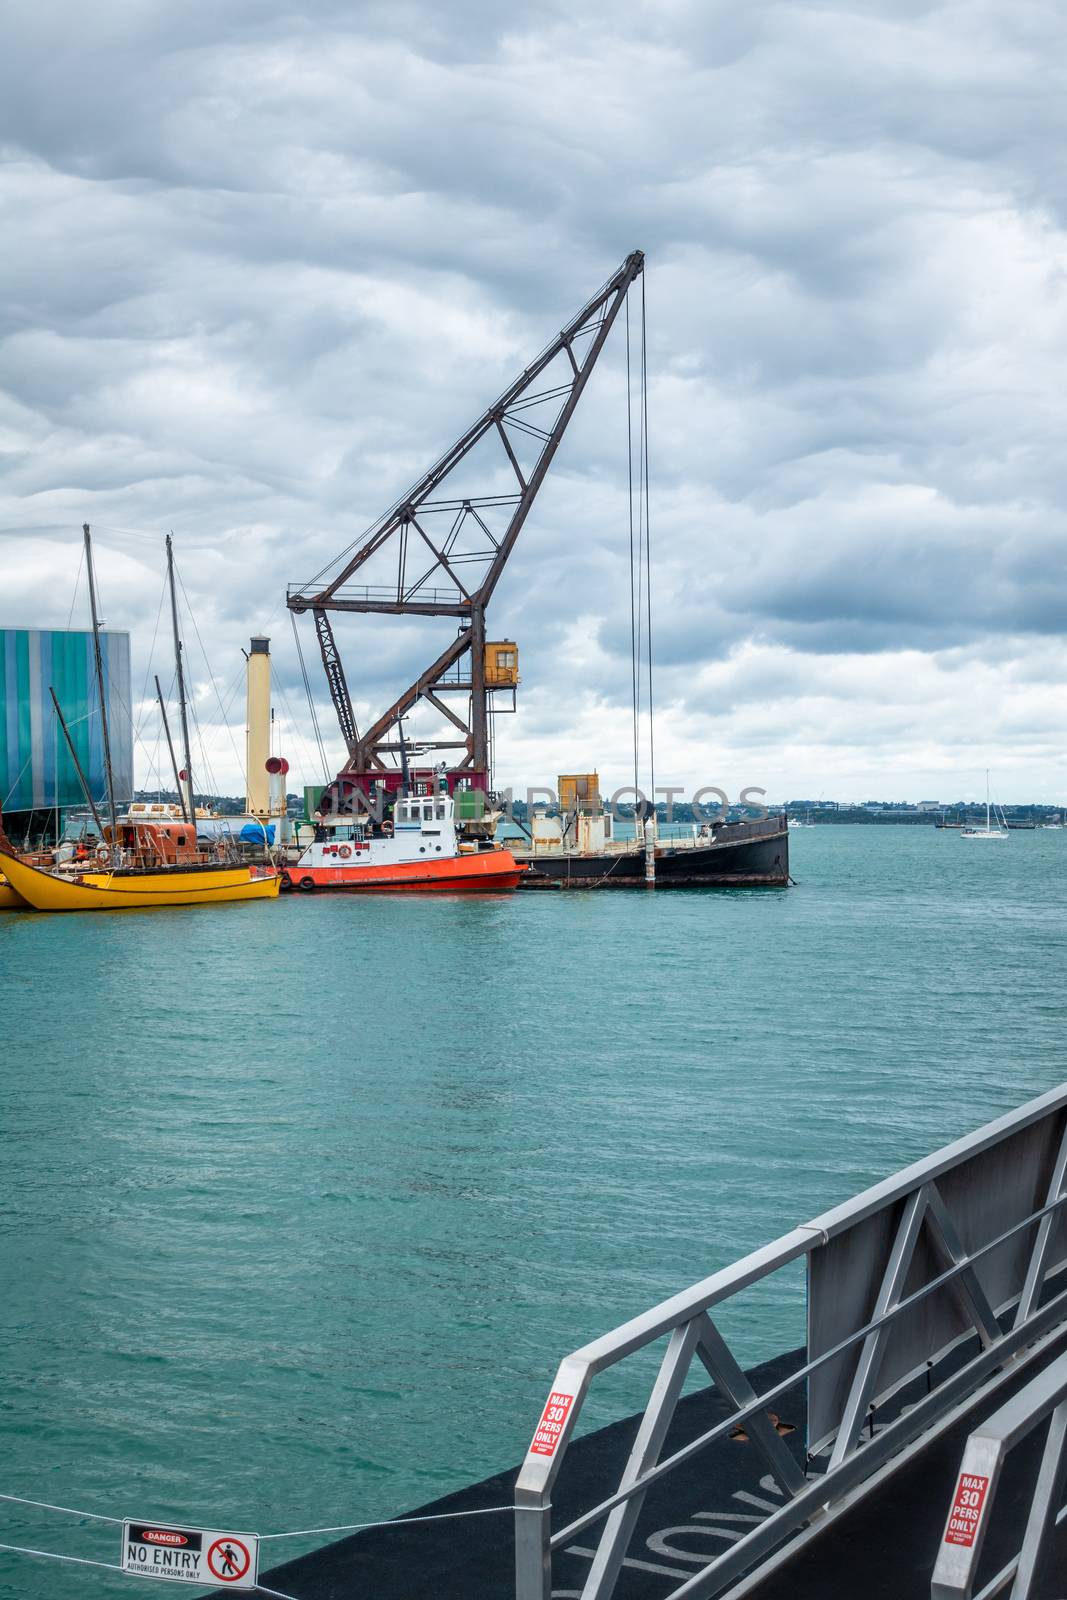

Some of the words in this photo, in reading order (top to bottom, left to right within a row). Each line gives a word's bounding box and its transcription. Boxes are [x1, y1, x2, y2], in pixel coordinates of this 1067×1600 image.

[550, 1395, 570, 1407] MAX
[547, 1406, 564, 1421] 30
[540, 1420, 562, 1433] PERS
[536, 1431, 558, 1444] ONLY
[962, 1477, 985, 1490] MAX
[960, 1490, 980, 1507] 30
[953, 1505, 979, 1520] PERS
[950, 1518, 976, 1533] ONLY
[148, 1533, 182, 1543] DANGER
[127, 1544, 147, 1562] NO
[153, 1549, 201, 1570] ENTRY
[127, 1562, 159, 1574] AUTHORISED
[160, 1568, 184, 1577] PERSONS
[185, 1571, 201, 1579] ONLY
